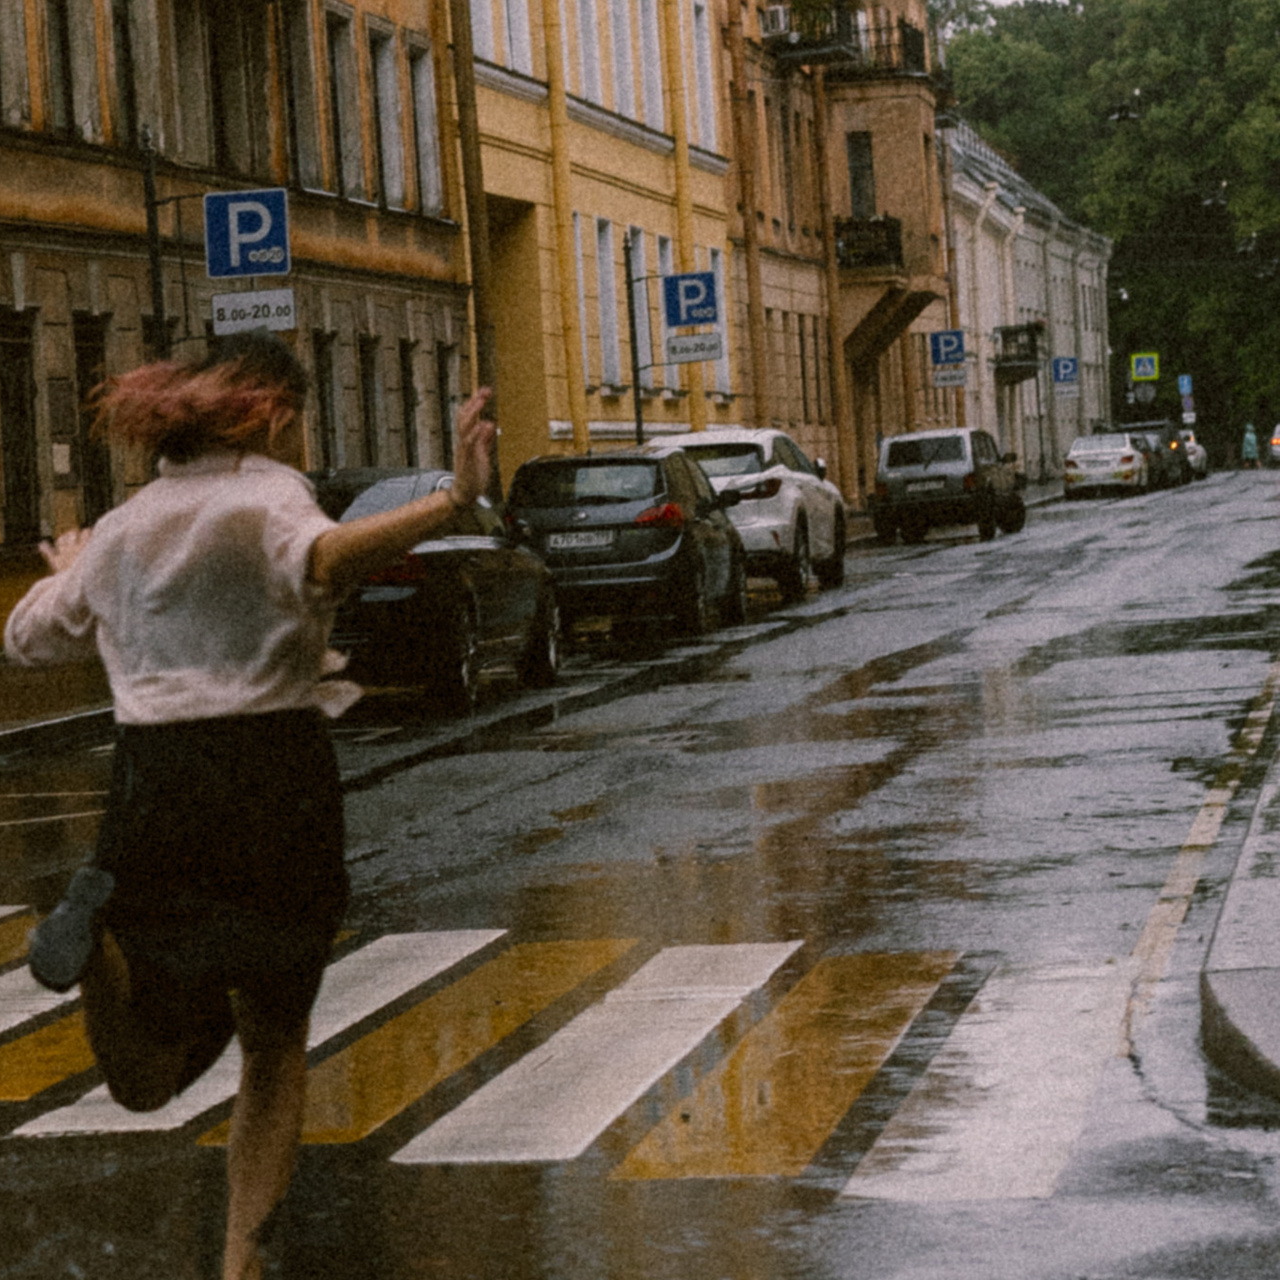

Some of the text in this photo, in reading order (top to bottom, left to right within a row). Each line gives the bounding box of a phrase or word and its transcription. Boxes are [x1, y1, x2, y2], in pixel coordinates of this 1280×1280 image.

[228, 201, 272, 267] P
[678, 280, 707, 321] P
[940, 335, 958, 361] P
